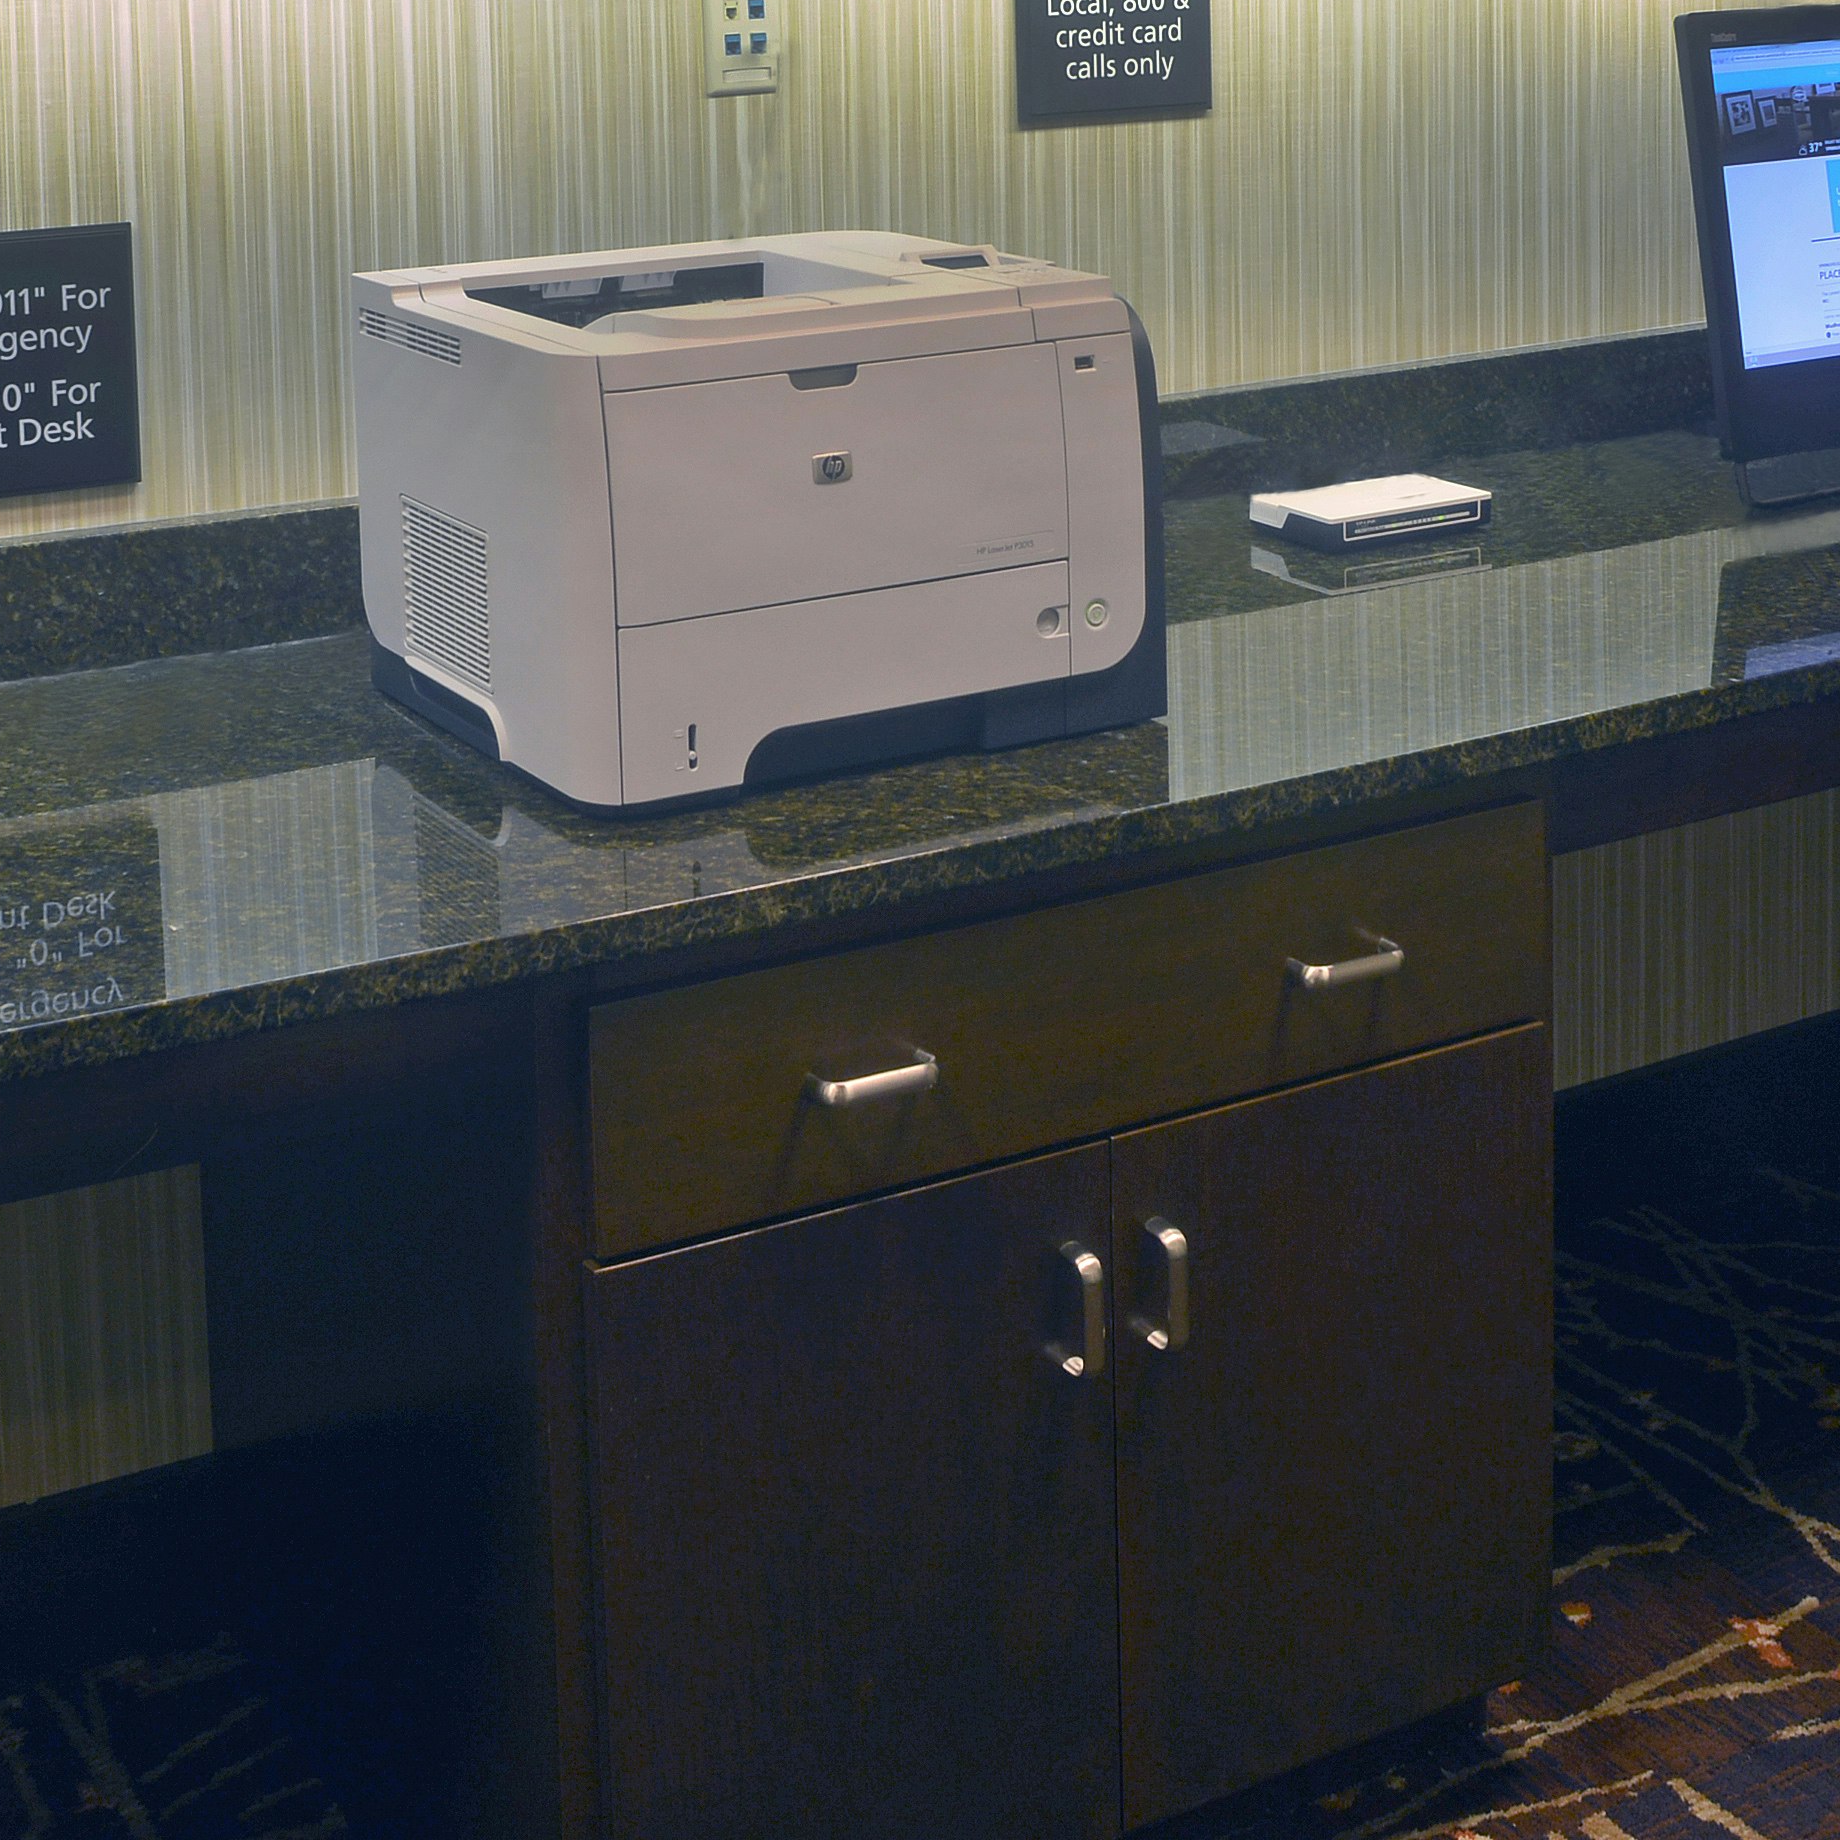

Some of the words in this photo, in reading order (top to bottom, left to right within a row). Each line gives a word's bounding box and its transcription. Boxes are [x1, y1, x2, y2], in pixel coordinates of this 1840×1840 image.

[1056, 21, 1125, 48] credit
[1133, 17, 1182, 44] card
[1066, 53, 1116, 80] calls
[1124, 50, 1174, 80] only
[61, 284, 111, 311] For
[52, 379, 101, 406] For
[19, 411, 95, 446] Desk
